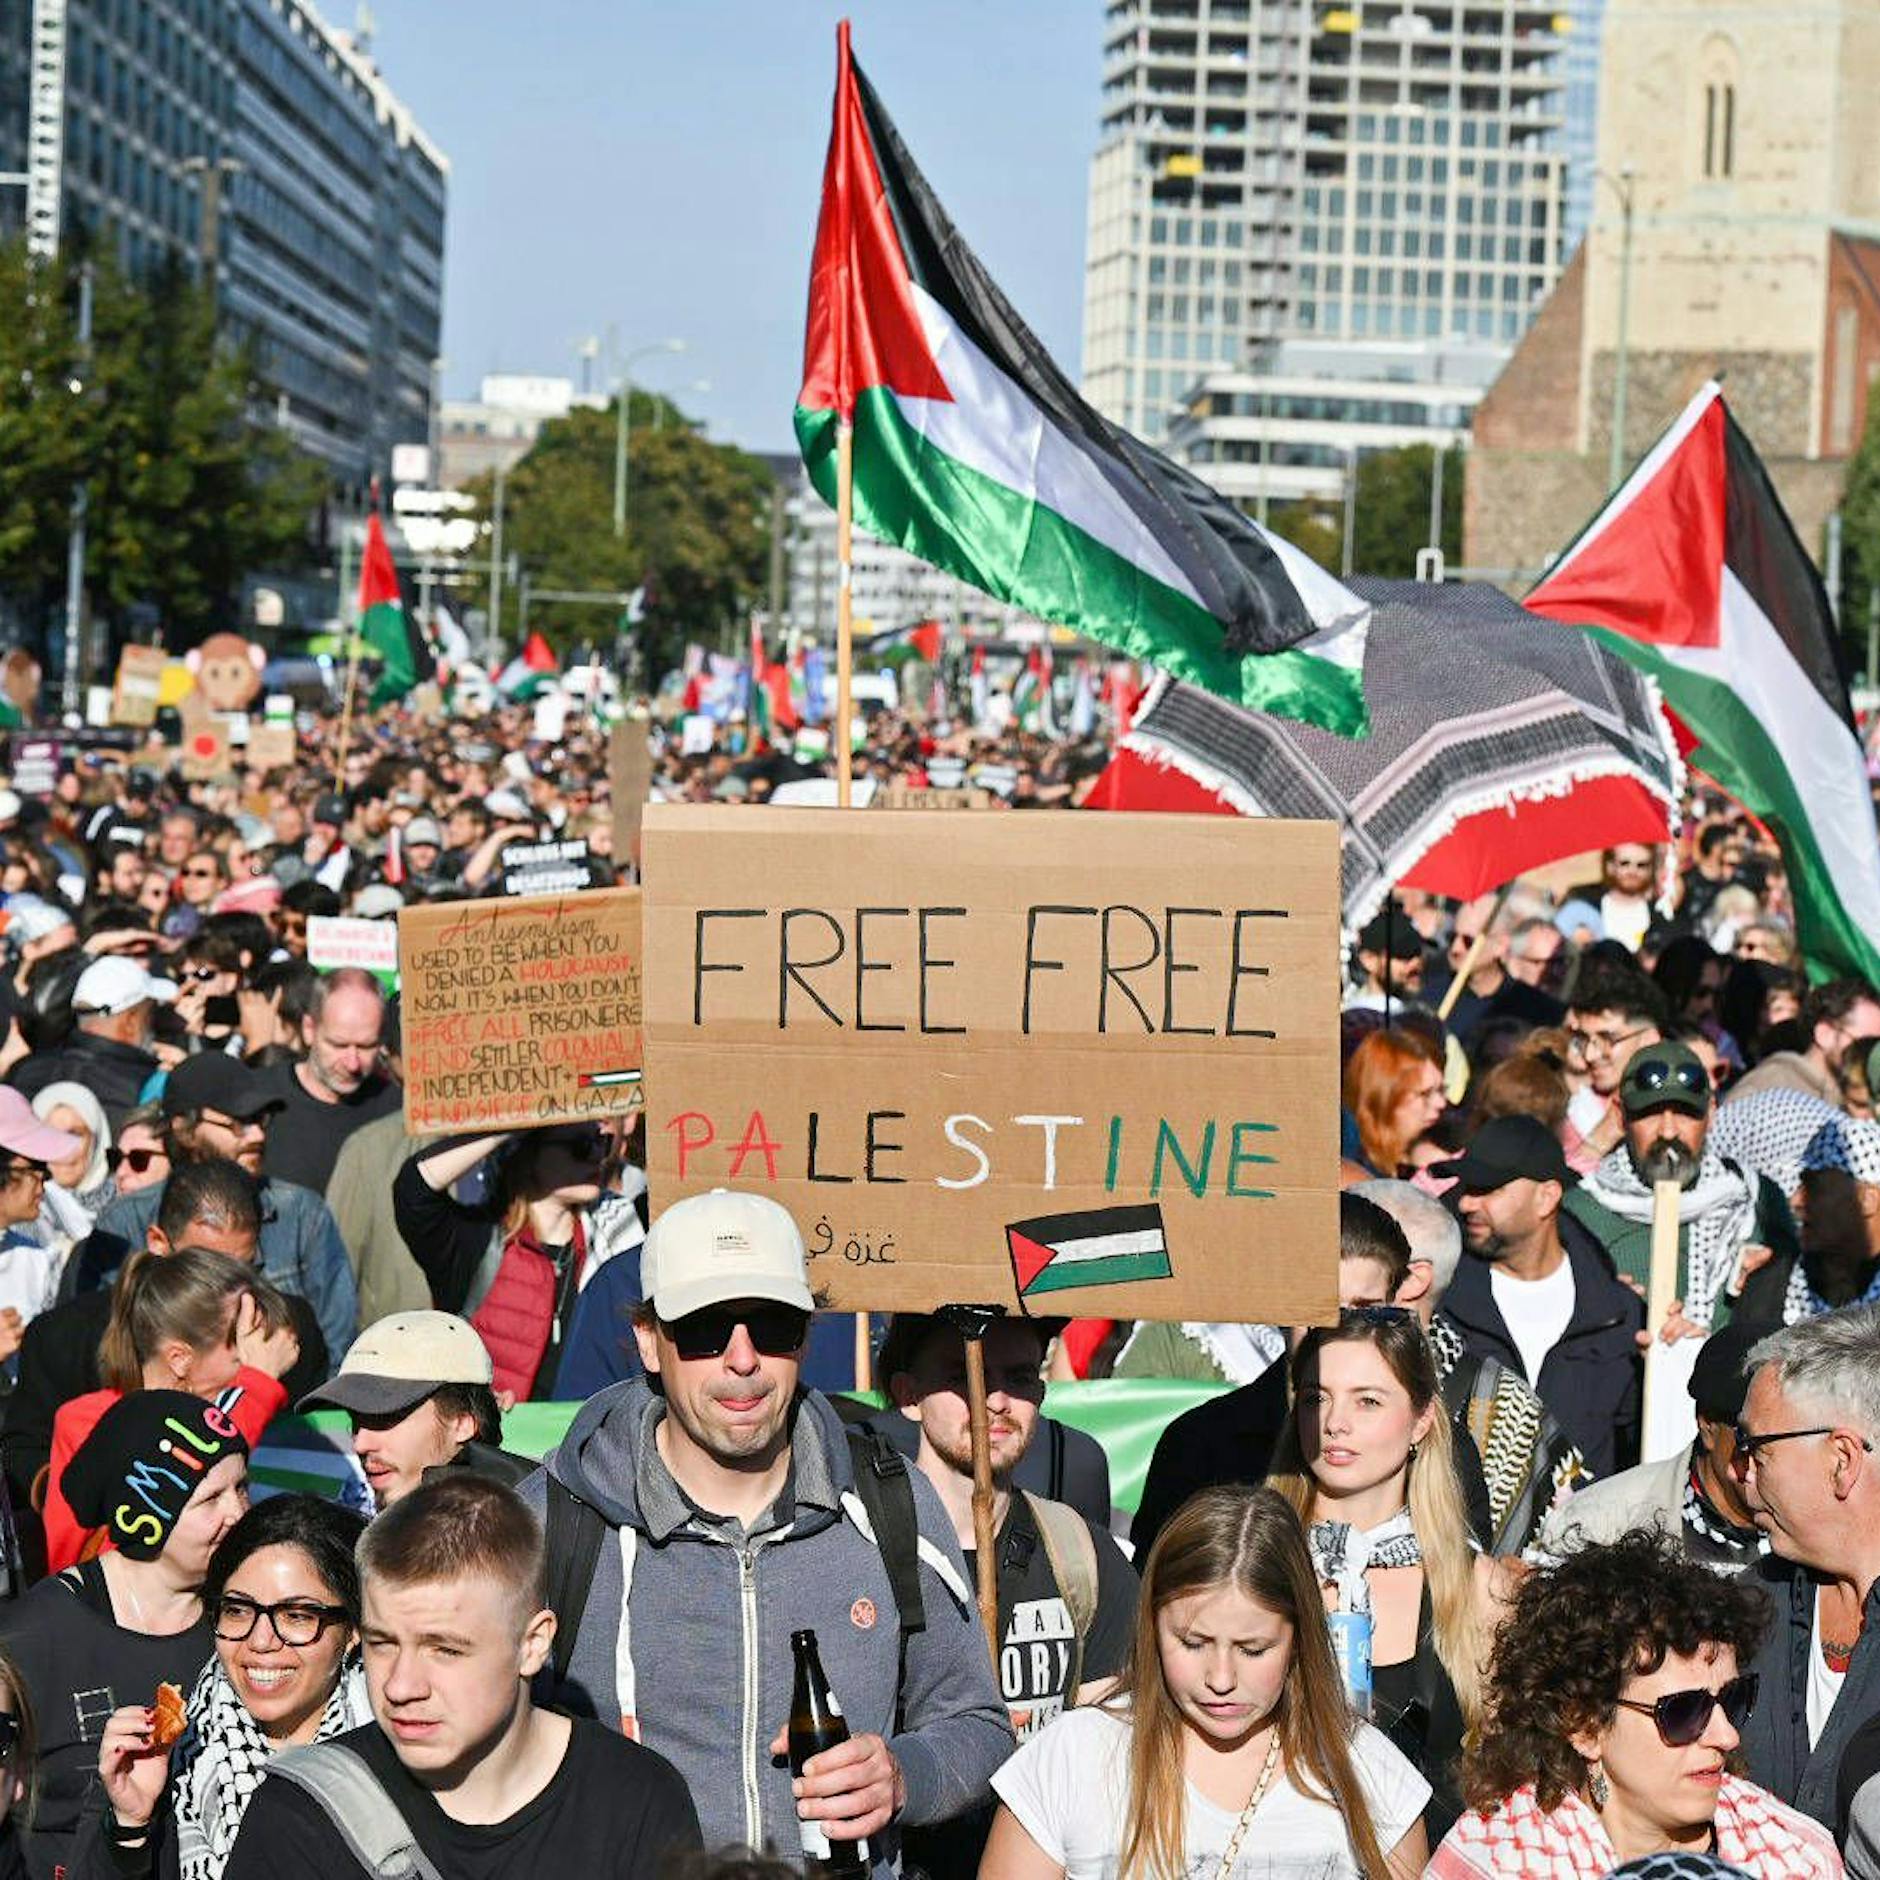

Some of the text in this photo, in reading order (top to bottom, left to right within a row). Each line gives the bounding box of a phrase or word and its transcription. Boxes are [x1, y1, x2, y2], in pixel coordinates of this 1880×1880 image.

[410, 947, 460, 972] USED
[463, 946, 485, 966] TO
[491, 941, 518, 966] BE
[519, 937, 574, 961] WHEN
[582, 932, 620, 955] YOU
[425, 965, 496, 991] DENIED
[498, 966, 515, 983] A
[693, 905, 1289, 1039] FREE FREE
[414, 974, 642, 1013] NOW IT'S WHEN YOU DON'T
[479, 1015, 524, 1041] ALL
[529, 1002, 642, 1036] PRISONERS
[470, 1038, 542, 1070] SETTLER
[423, 1063, 562, 1101] INDEPENDENT
[537, 1091, 568, 1119] ON
[574, 1084, 644, 1115] GAZA
[666, 1110, 1281, 1199] PALESTINE
[844, 1232, 897, 1266] غزة
